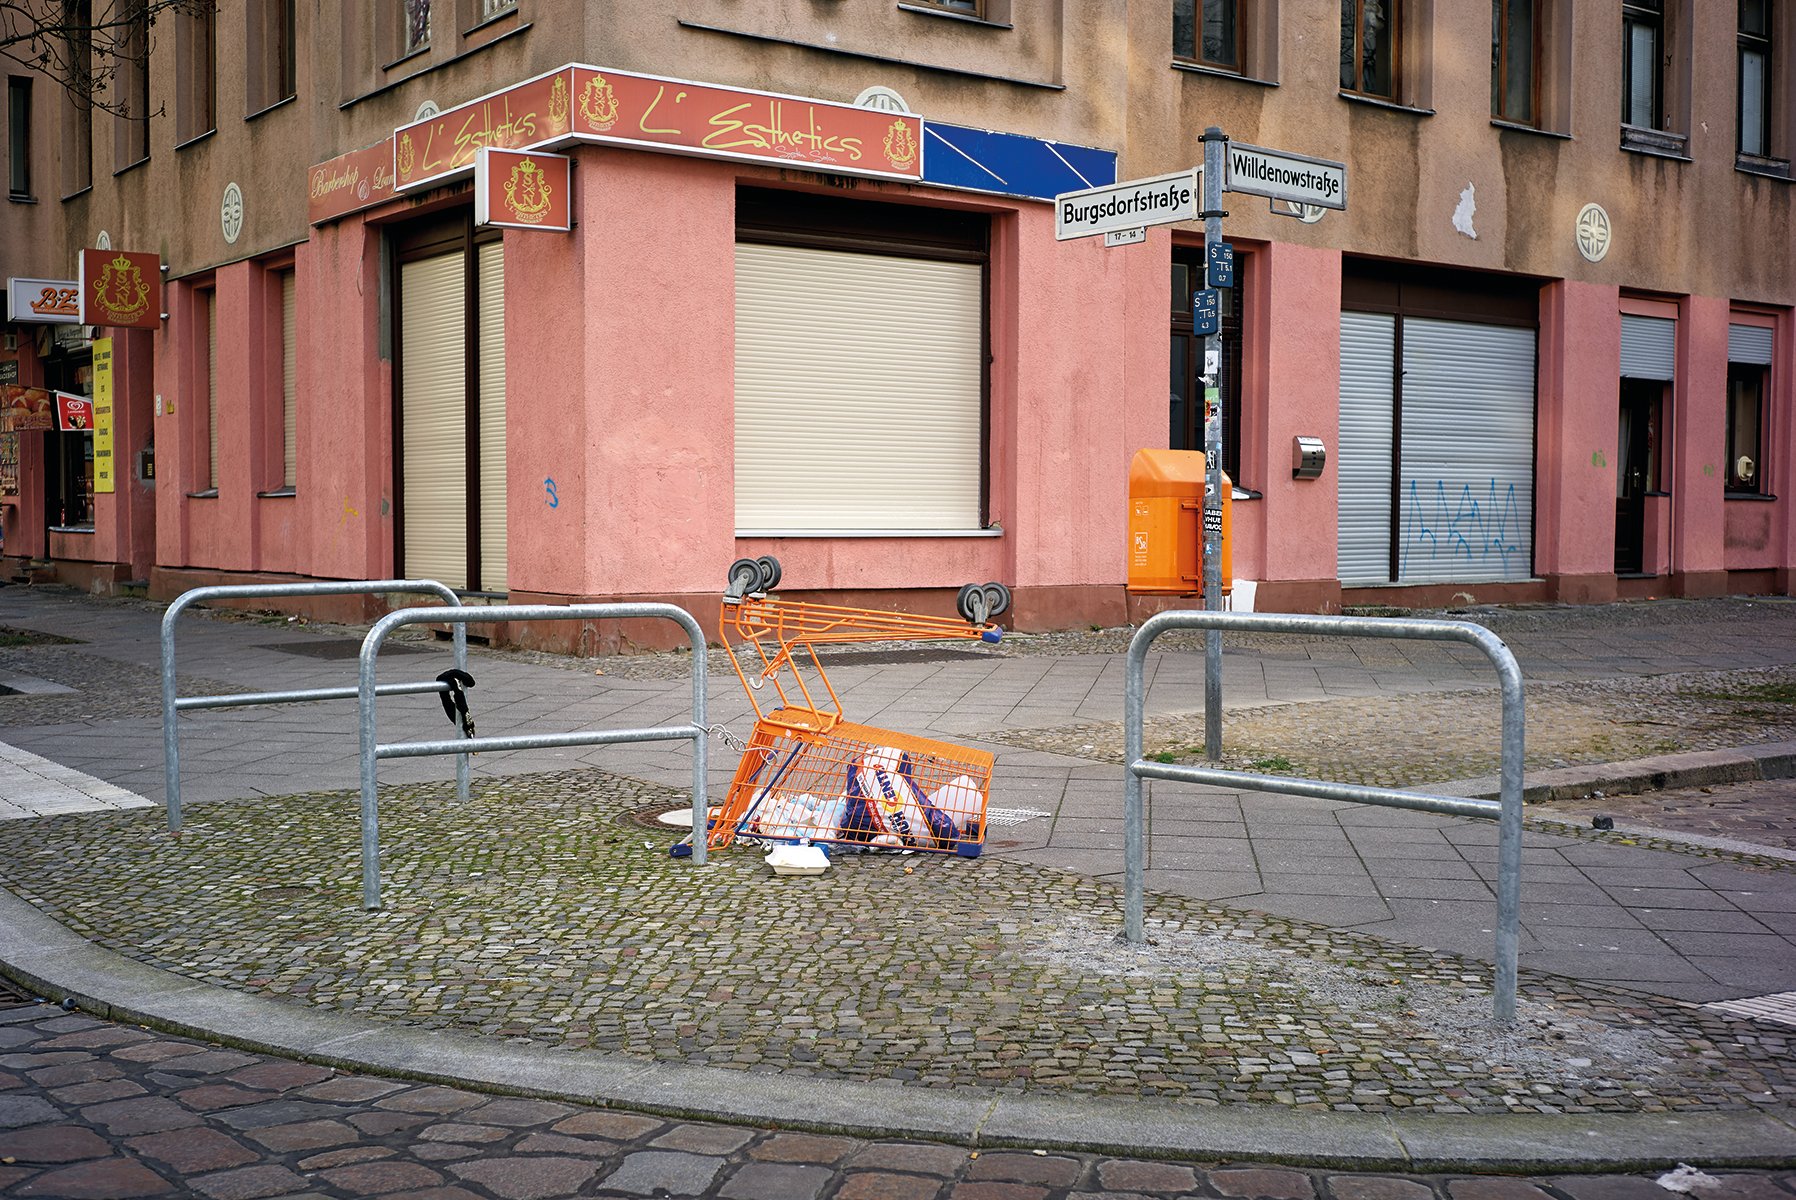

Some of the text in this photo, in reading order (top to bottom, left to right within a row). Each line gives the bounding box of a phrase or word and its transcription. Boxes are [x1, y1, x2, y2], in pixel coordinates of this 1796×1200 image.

[450, 95, 537, 169] Esthetics
[702, 100, 863, 161] Esthetics
[311, 165, 359, 198] Barbershop
[1233, 153, 1339, 198] Willdenowstraße
[1064, 184, 1190, 225] Burgsdorfstraße
[1211, 247, 1218, 258] S
[1194, 297, 1201, 308] S
